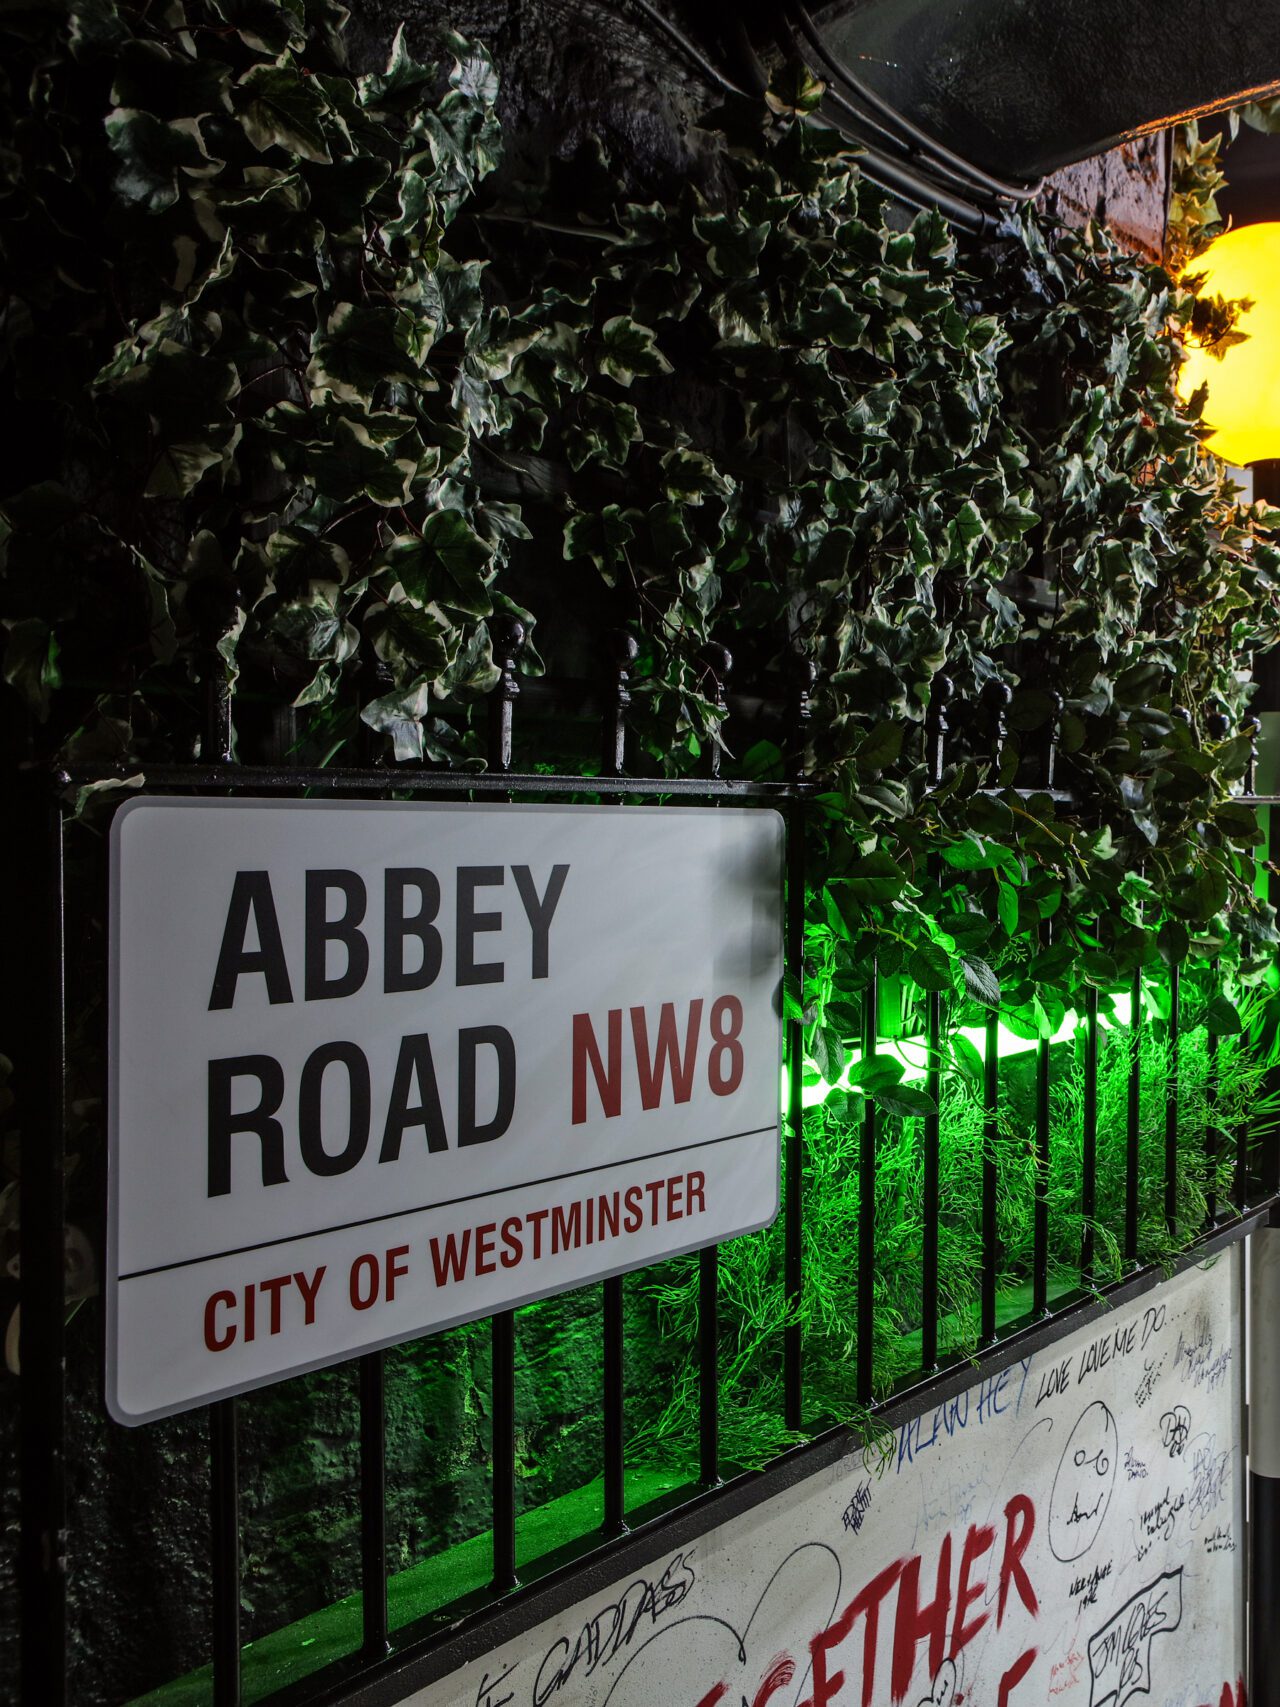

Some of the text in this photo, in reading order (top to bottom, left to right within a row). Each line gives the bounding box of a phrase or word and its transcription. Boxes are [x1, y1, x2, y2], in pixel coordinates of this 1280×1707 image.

[207, 863, 571, 1012] ABBEY
[206, 994, 745, 1199] ROAD NW8
[203, 1170, 707, 1353] CITY OF WESTMINSTER
